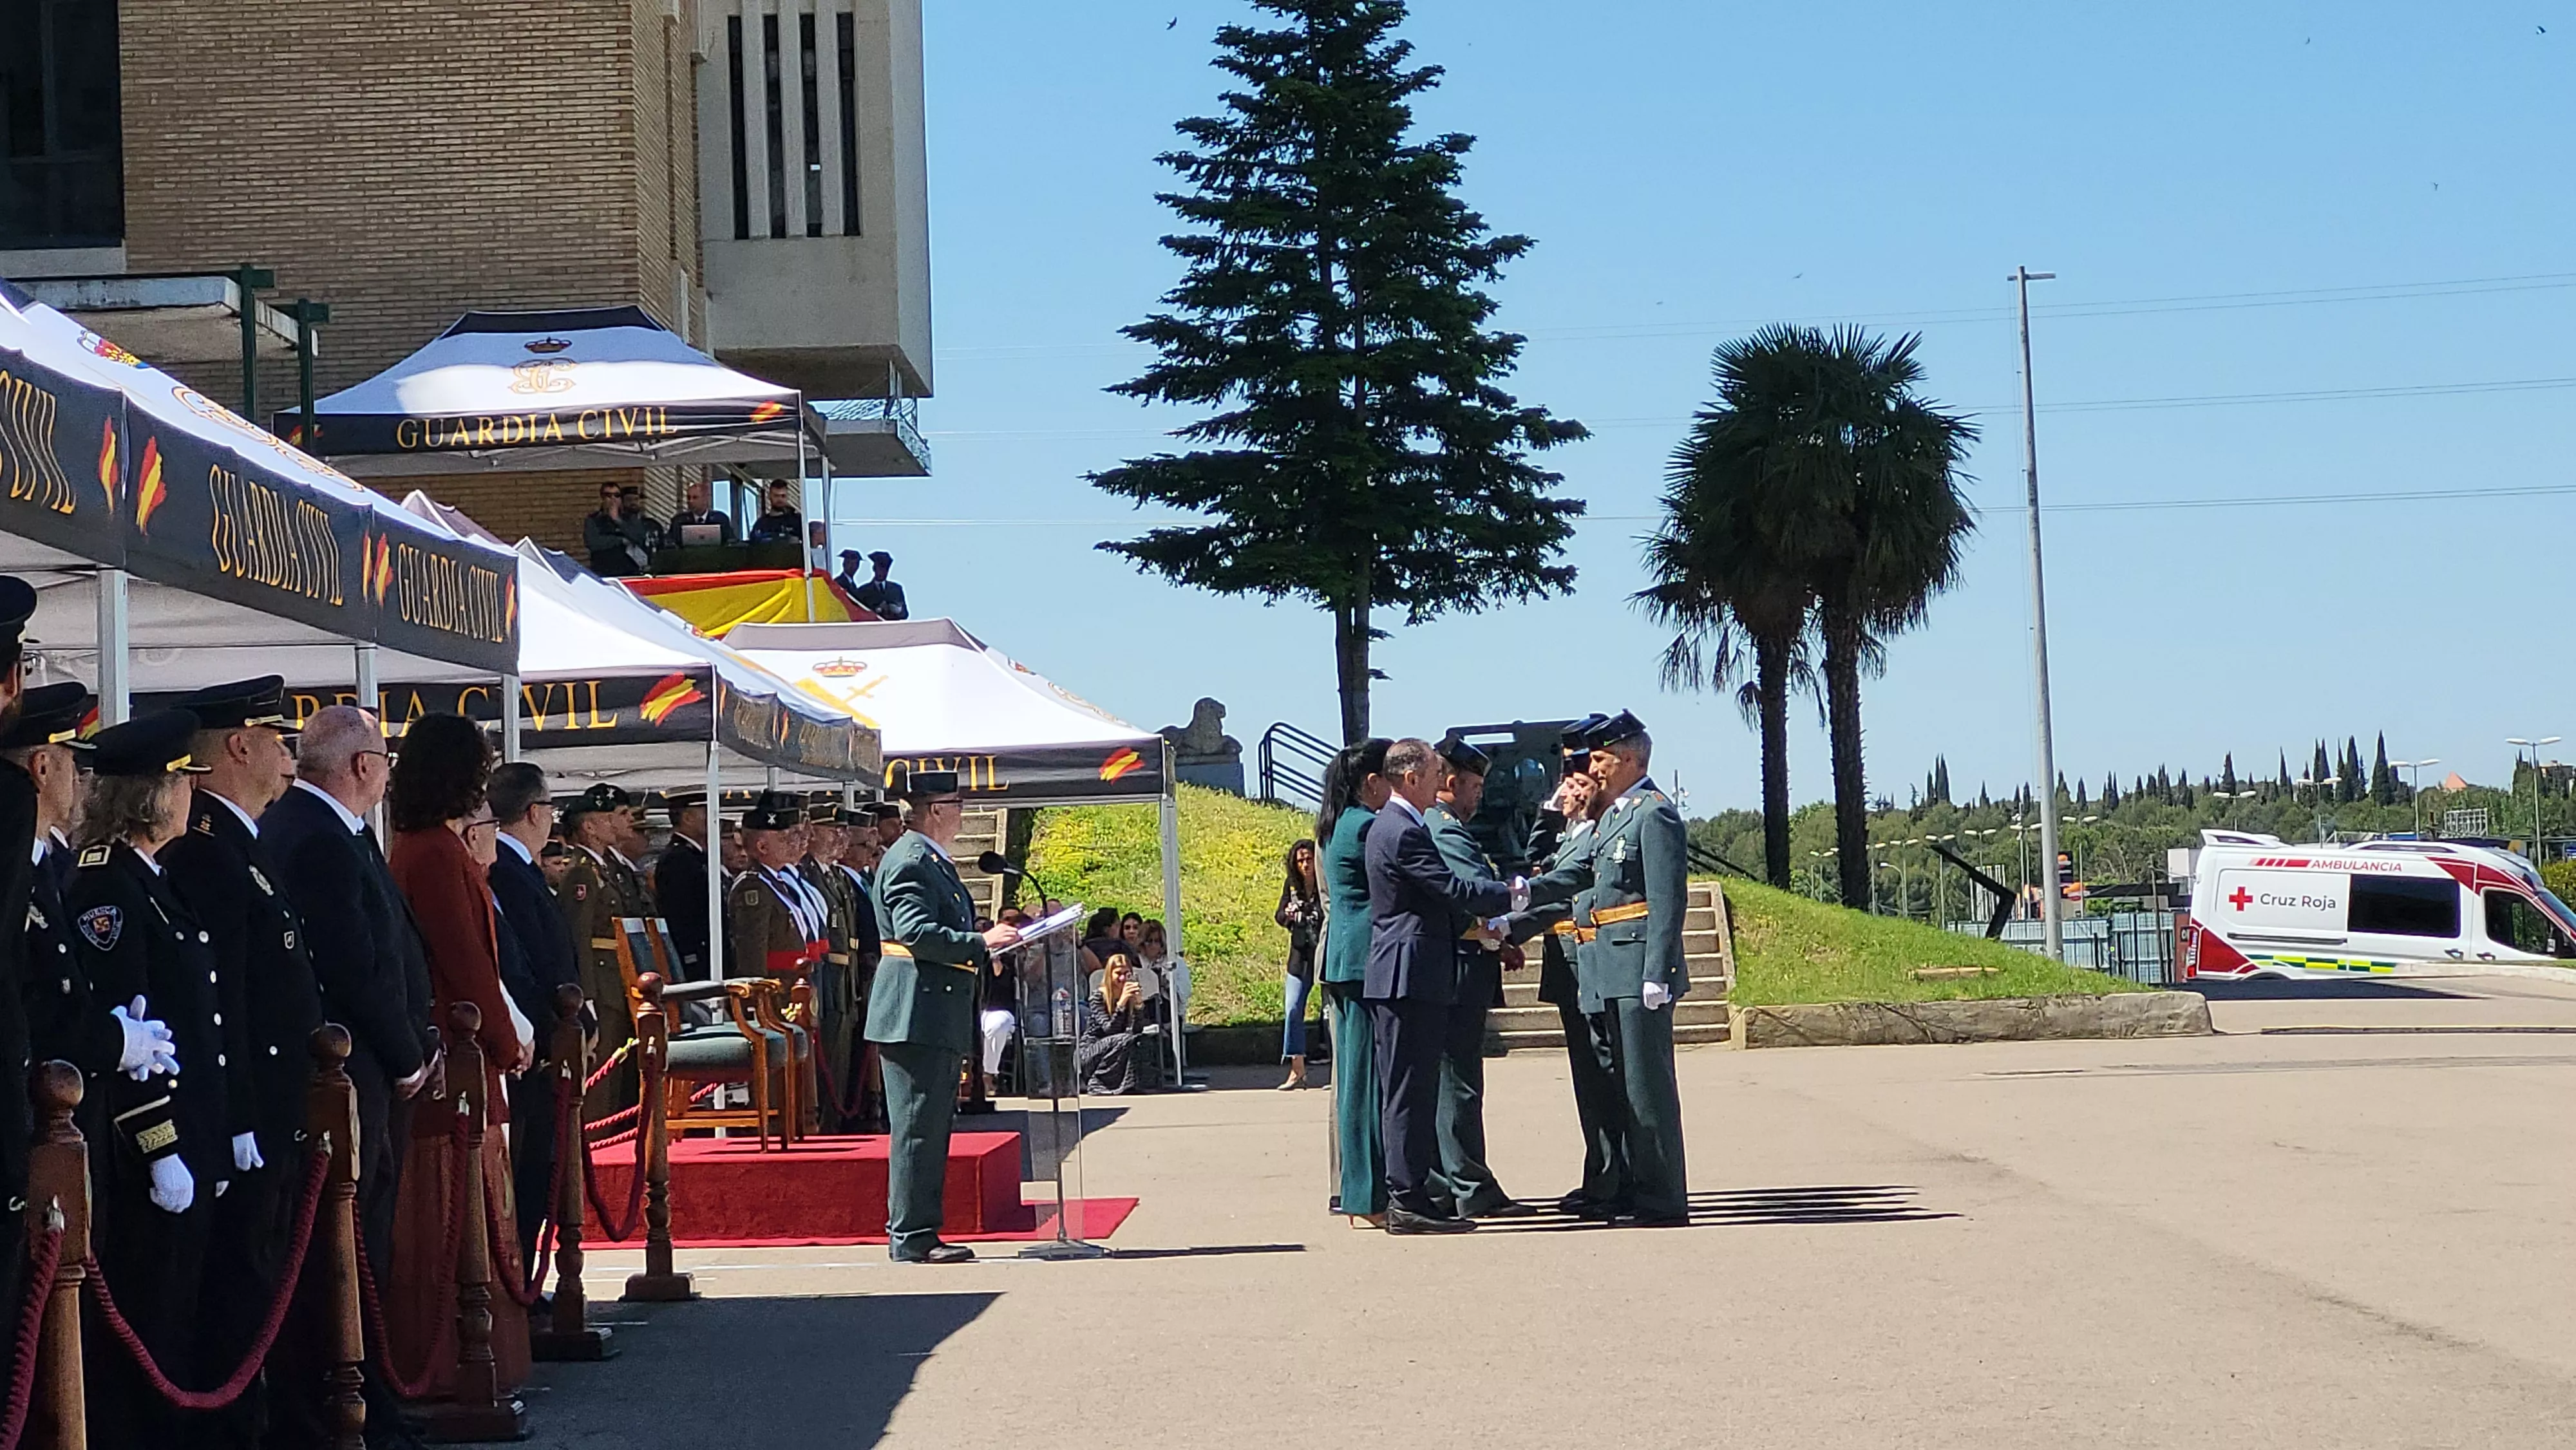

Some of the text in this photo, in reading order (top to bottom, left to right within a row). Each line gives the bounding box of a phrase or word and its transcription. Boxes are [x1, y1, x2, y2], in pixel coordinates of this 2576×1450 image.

[397, 406, 677, 449] GUARDIA CIVIL
[209, 464, 343, 606] GUARDIA CIVIL
[398, 543, 504, 643] GUARDIA CIVIL
[457, 681, 618, 731] CVIL
[2311, 860, 2403, 872] AMBULANCIA
[2260, 893, 2336, 911] Cruz Roja
